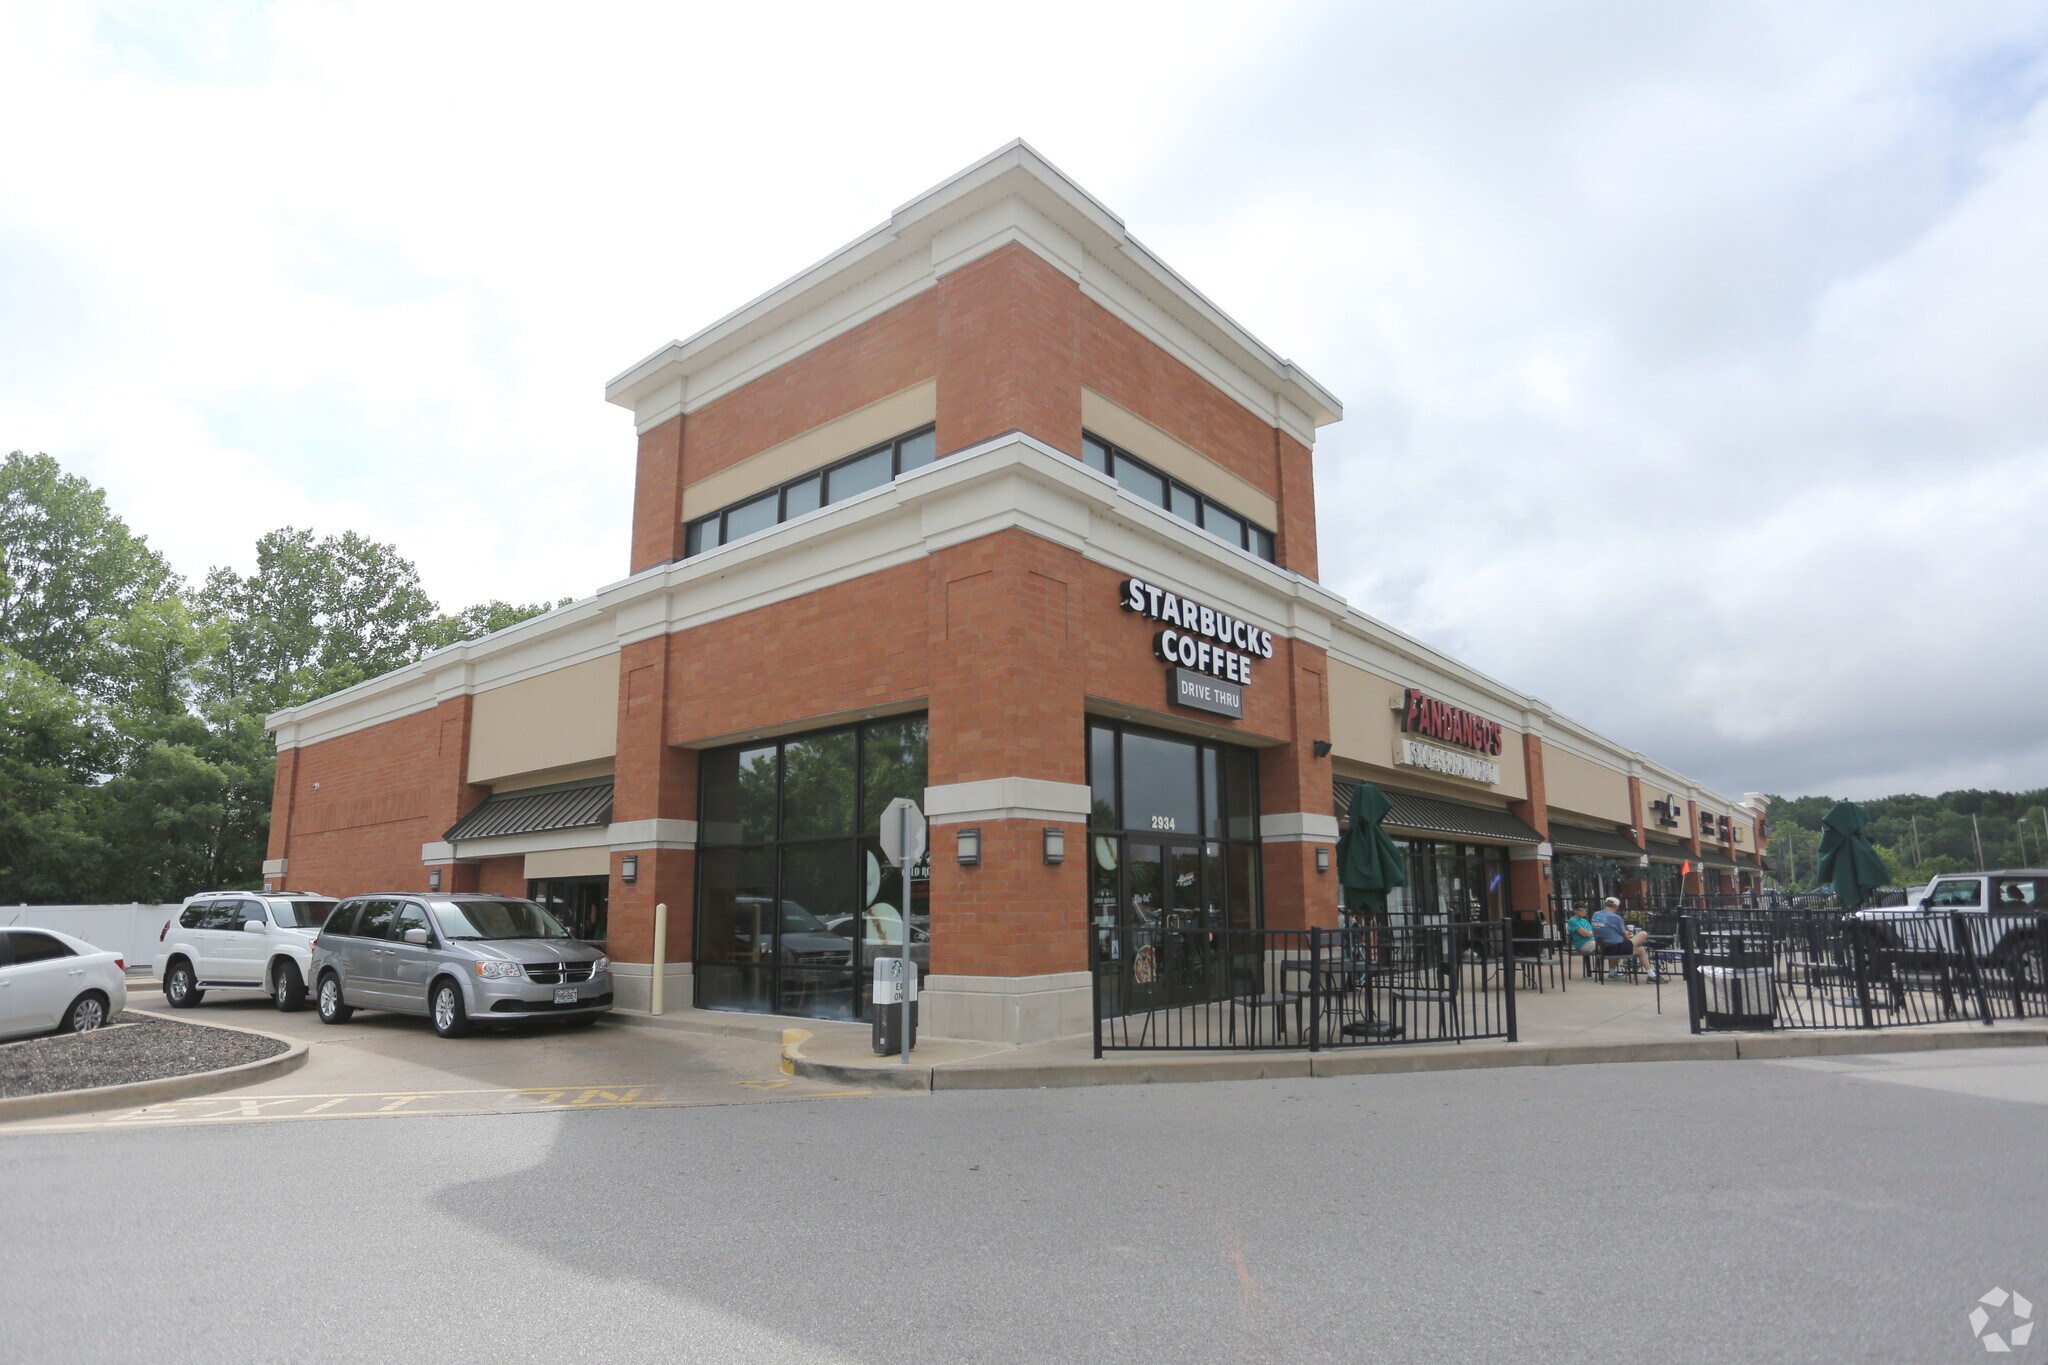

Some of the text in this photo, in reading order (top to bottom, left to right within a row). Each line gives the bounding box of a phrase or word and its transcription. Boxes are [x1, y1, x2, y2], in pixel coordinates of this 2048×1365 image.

[1129, 578, 1273, 659] STARBUCKS
[1161, 629, 1251, 685] COFFEE
[1181, 680, 1239, 708] DRIVE THRU
[1406, 688, 1503, 757] FANDANGO'S
[1151, 815, 1176, 831] 2934
[107, 1095, 440, 1122] EXIT
